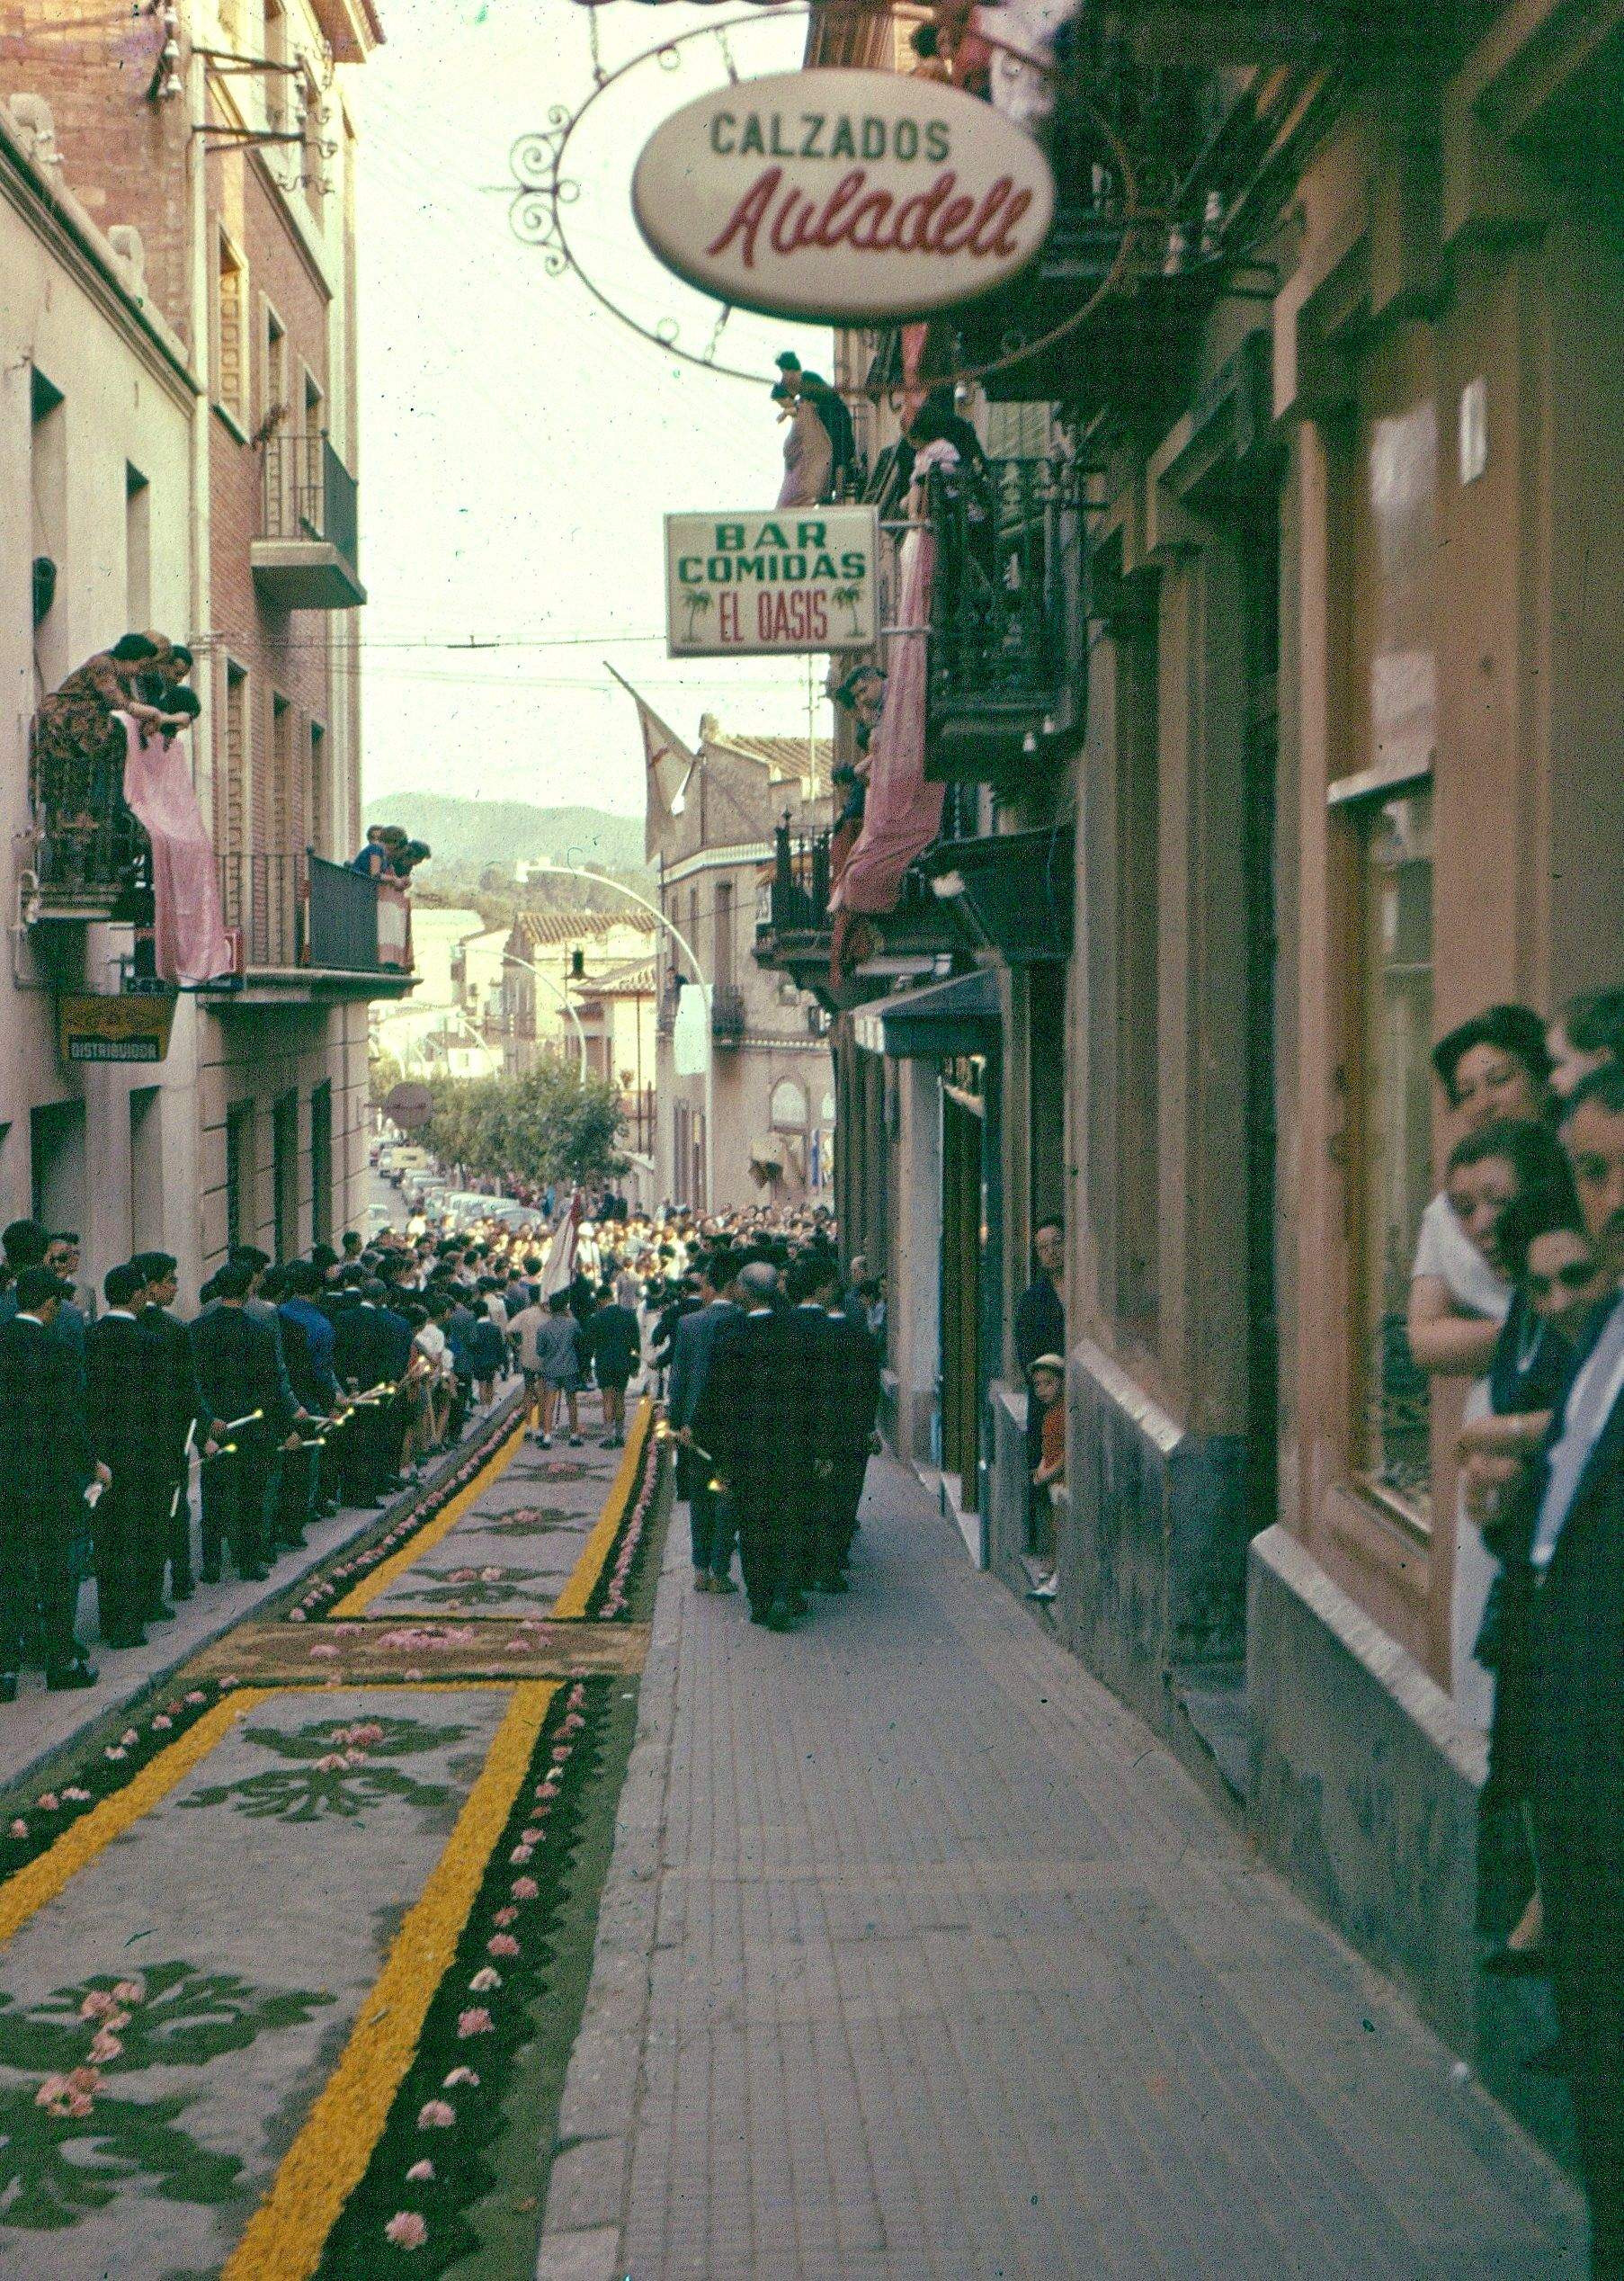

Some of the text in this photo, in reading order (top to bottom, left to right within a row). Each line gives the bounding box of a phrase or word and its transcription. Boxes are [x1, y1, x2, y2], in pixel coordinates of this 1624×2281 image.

[710, 112, 950, 162] CALZADOS
[707, 166, 1033, 268] Auladell
[715, 522, 826, 550] BAR
[679, 554, 865, 582] COMIDAS
[720, 590, 827, 641] EL OASIS
